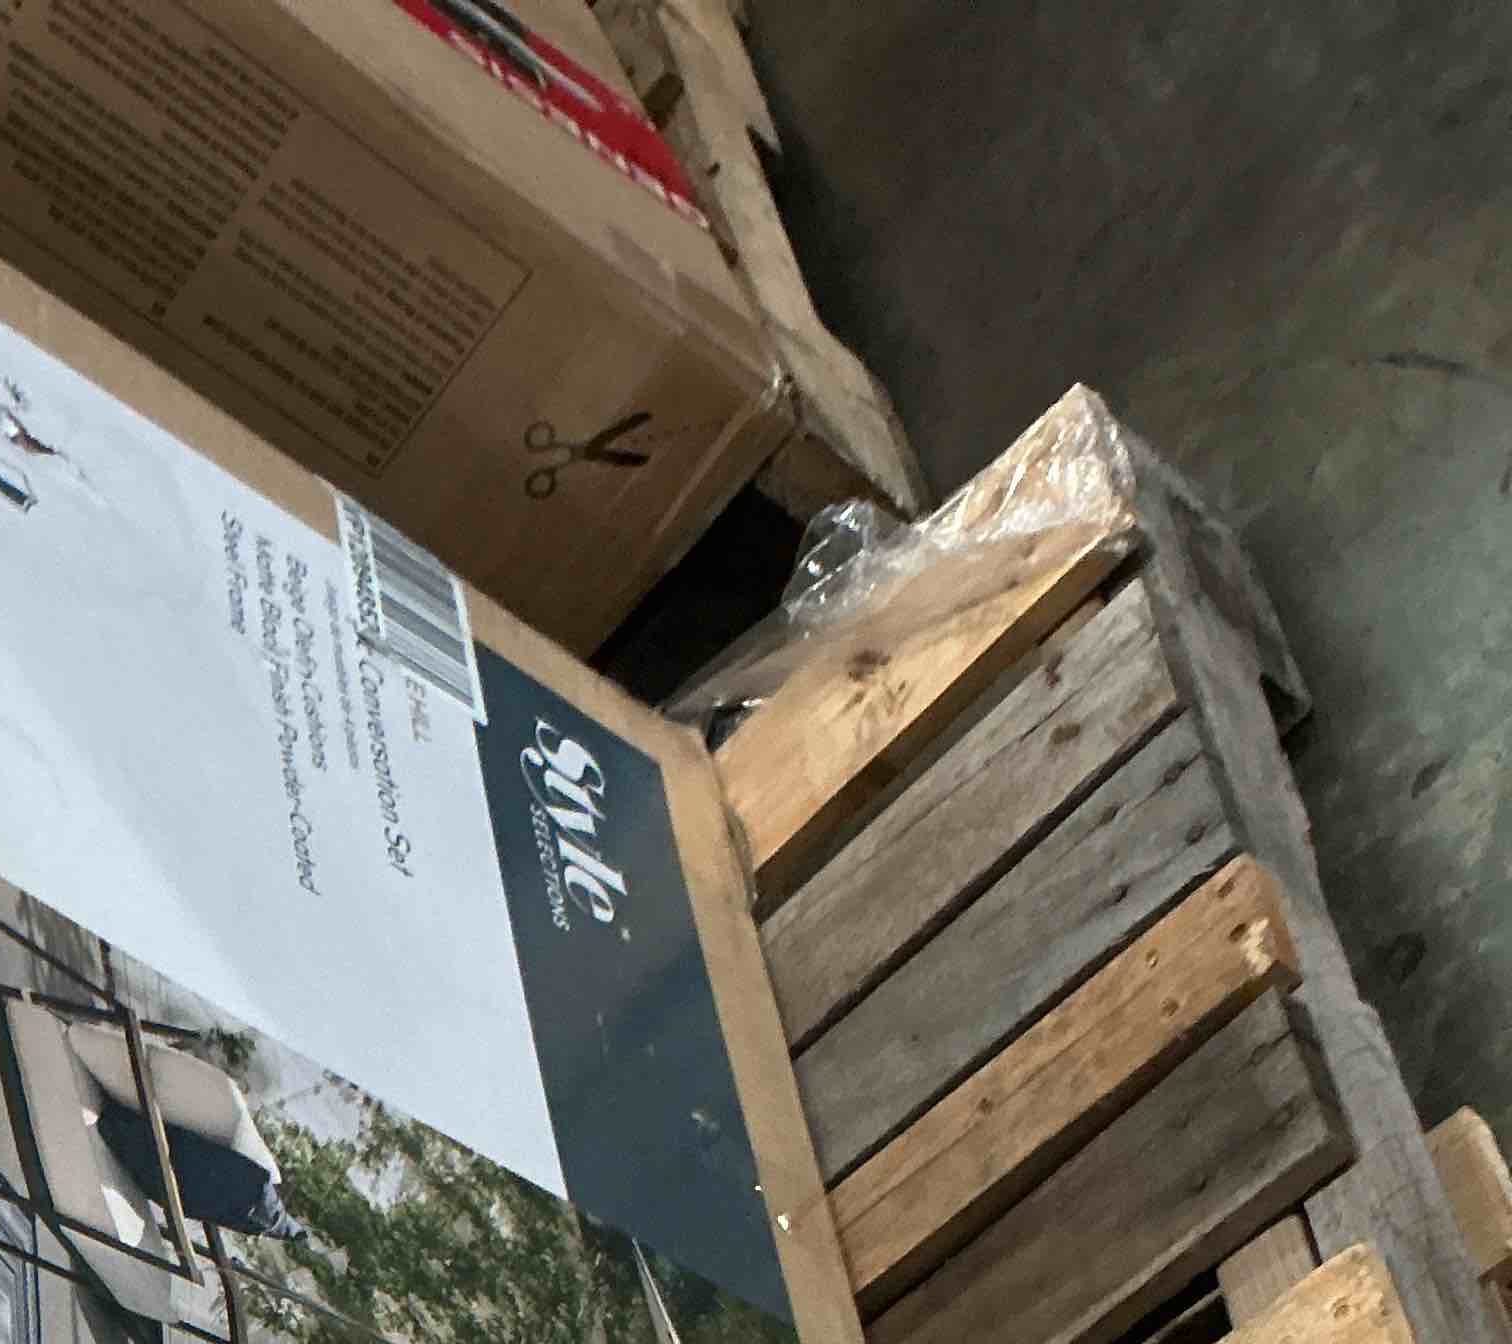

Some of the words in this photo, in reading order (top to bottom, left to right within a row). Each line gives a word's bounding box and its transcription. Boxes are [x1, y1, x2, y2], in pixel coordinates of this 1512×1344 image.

[226, 566, 248, 635] Frame
[276, 719, 320, 896] Powder-Coated
[358, 658, 400, 824] Conversation
[384, 826, 413, 877] Set
[519, 717, 628, 924] Style
[530, 800, 570, 932] SELECTIONS
